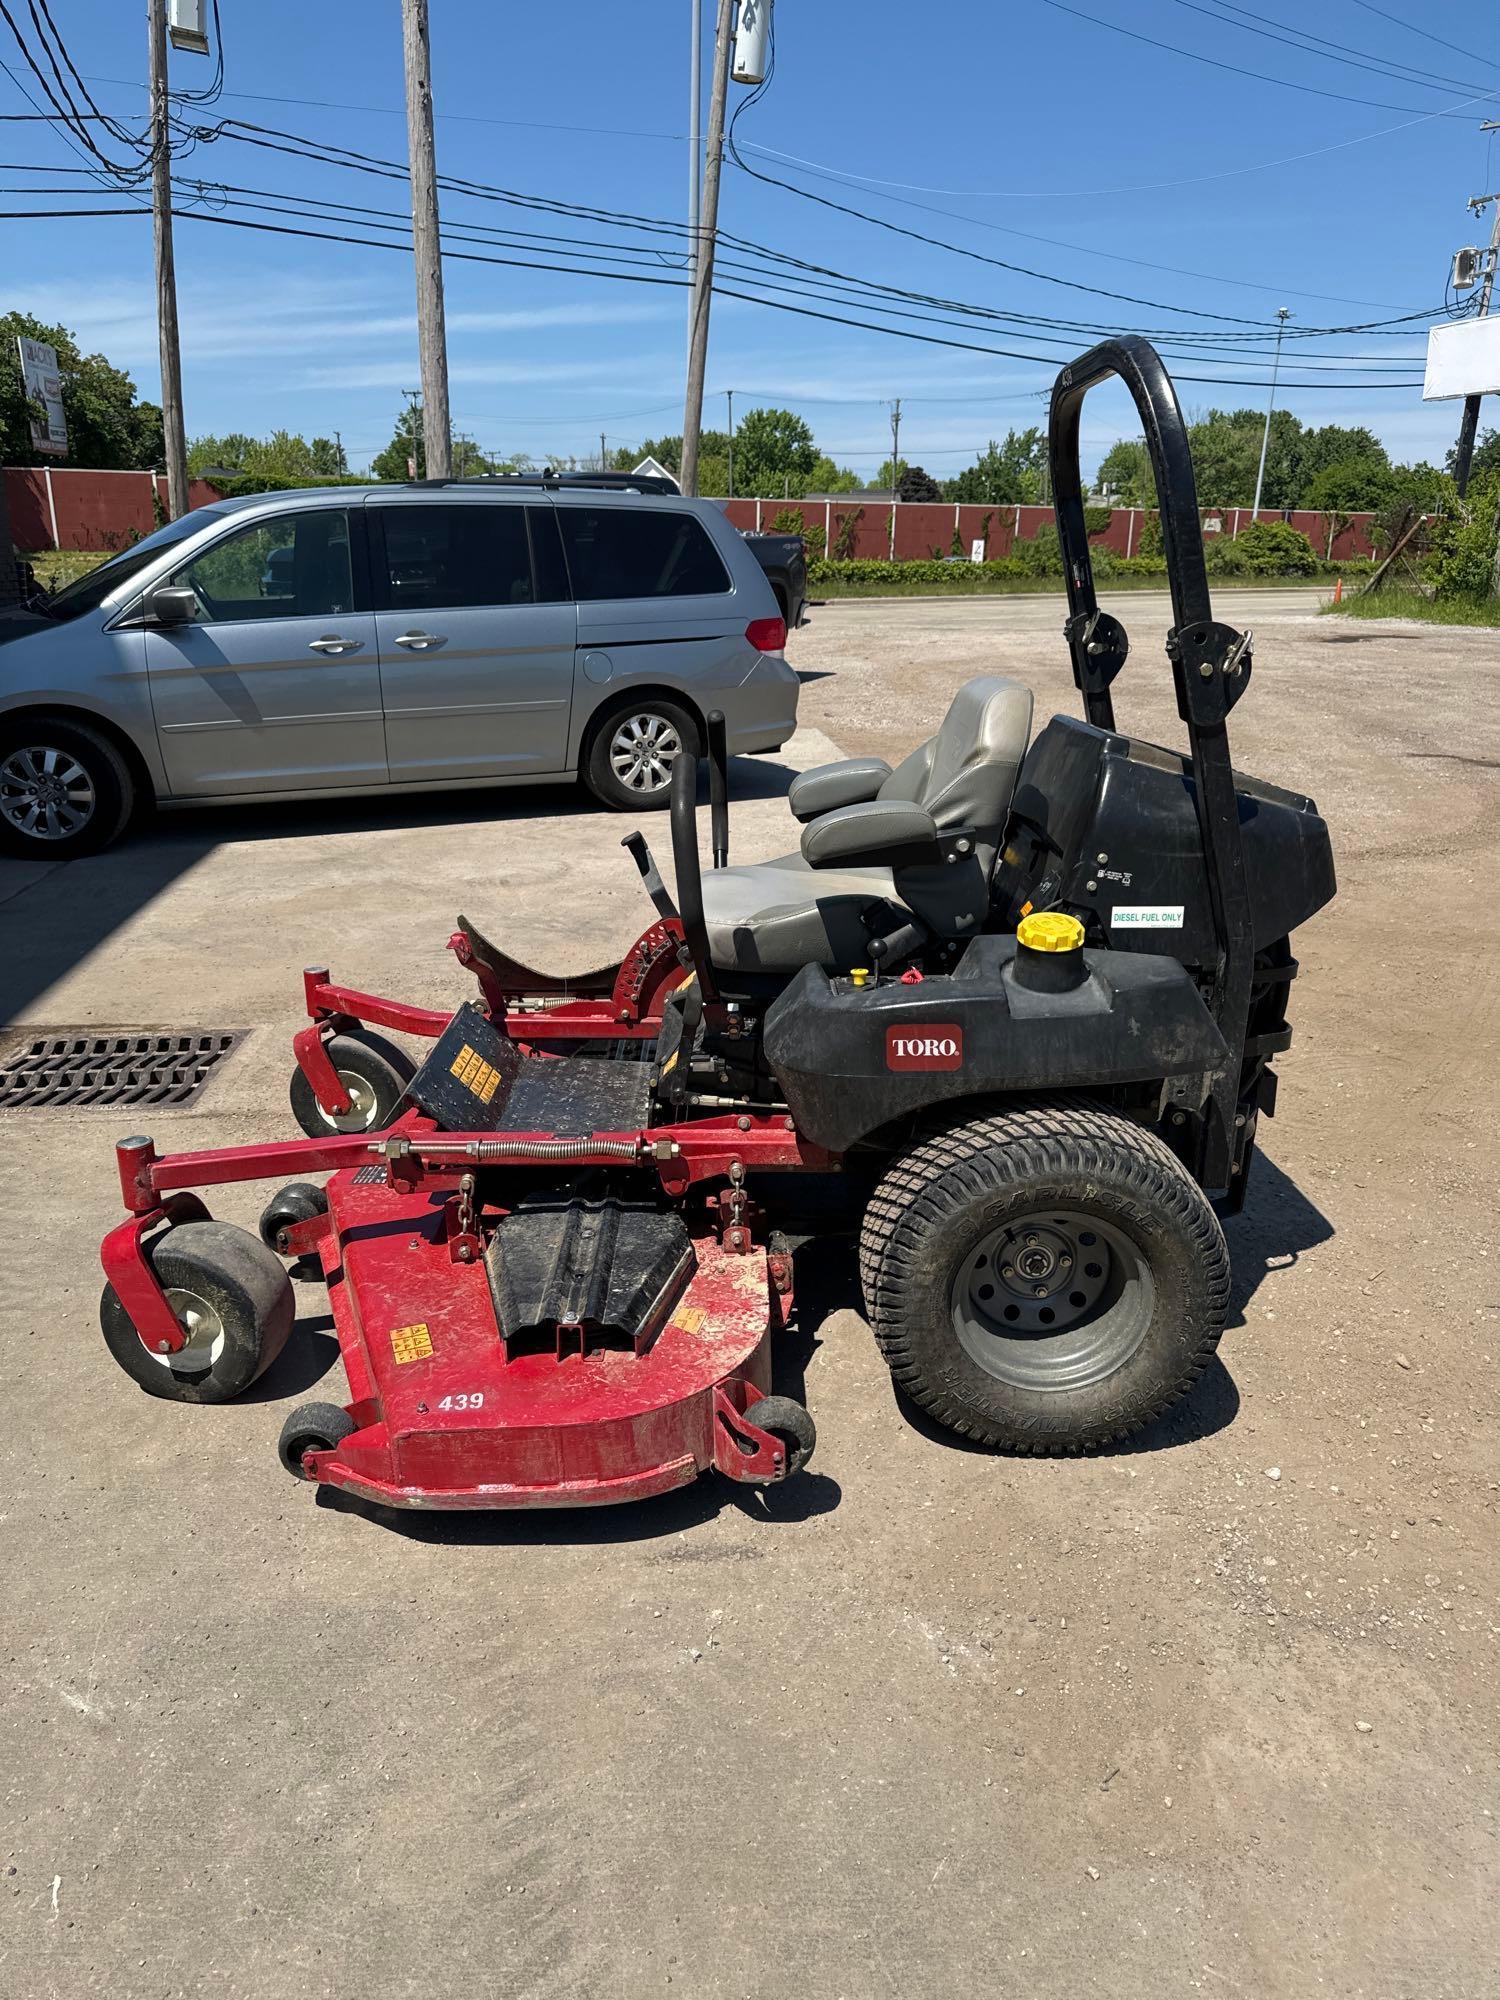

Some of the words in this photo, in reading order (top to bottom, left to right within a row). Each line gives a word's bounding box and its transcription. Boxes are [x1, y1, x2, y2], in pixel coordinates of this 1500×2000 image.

[1113, 913, 1139, 922] DIESEL
[1141, 913, 1160, 922] FUEL
[1161, 913, 1182, 922] ONLY
[892, 1038, 957, 1057] TORO
[438, 1392, 484, 1411] 439
